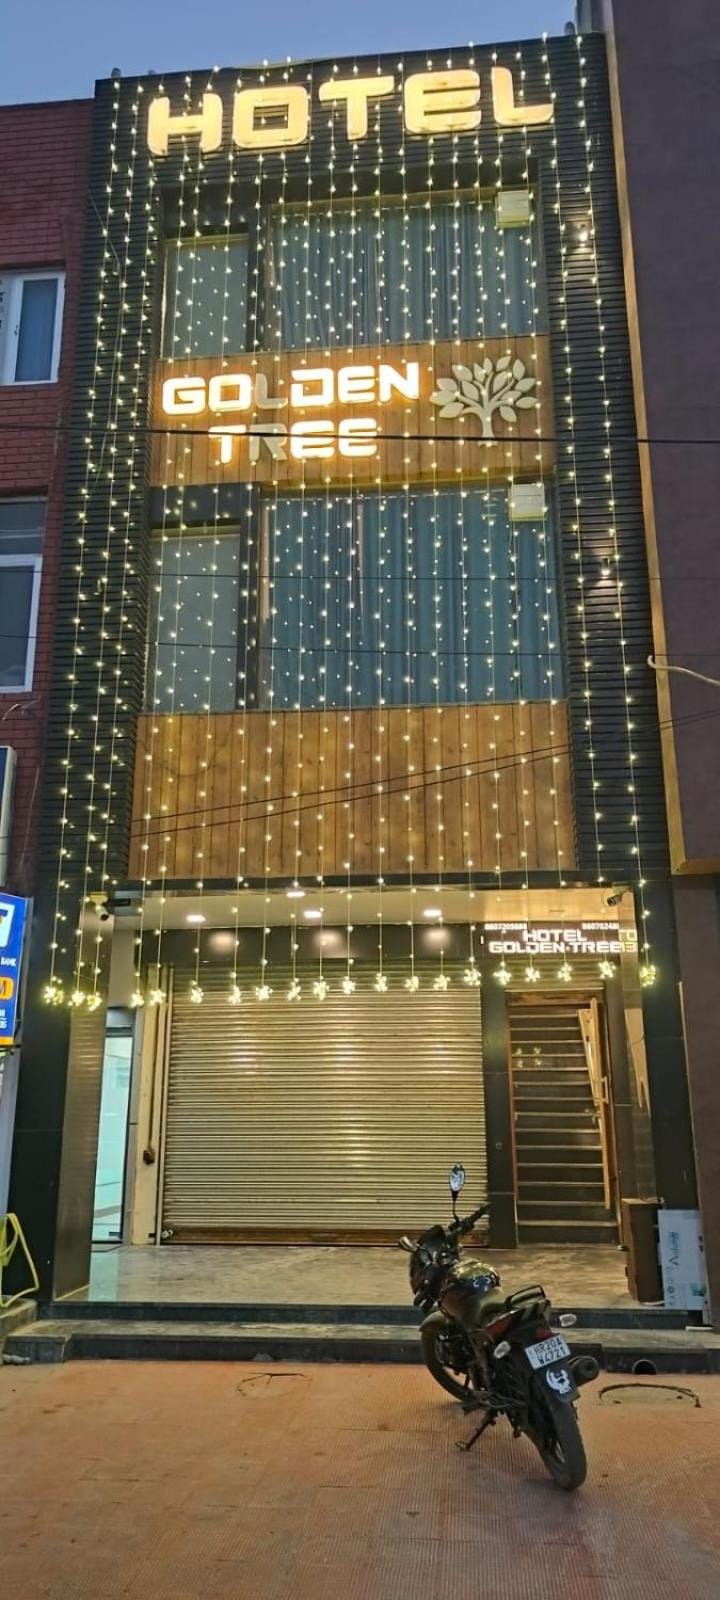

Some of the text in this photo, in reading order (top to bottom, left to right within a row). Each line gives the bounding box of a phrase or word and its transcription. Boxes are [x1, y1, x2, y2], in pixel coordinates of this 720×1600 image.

[147, 66, 554, 157] HOTEL
[161, 361, 421, 416] GOLDEN
[208, 417, 378, 464] TREE
[522, 929, 588, 942] HOTEL
